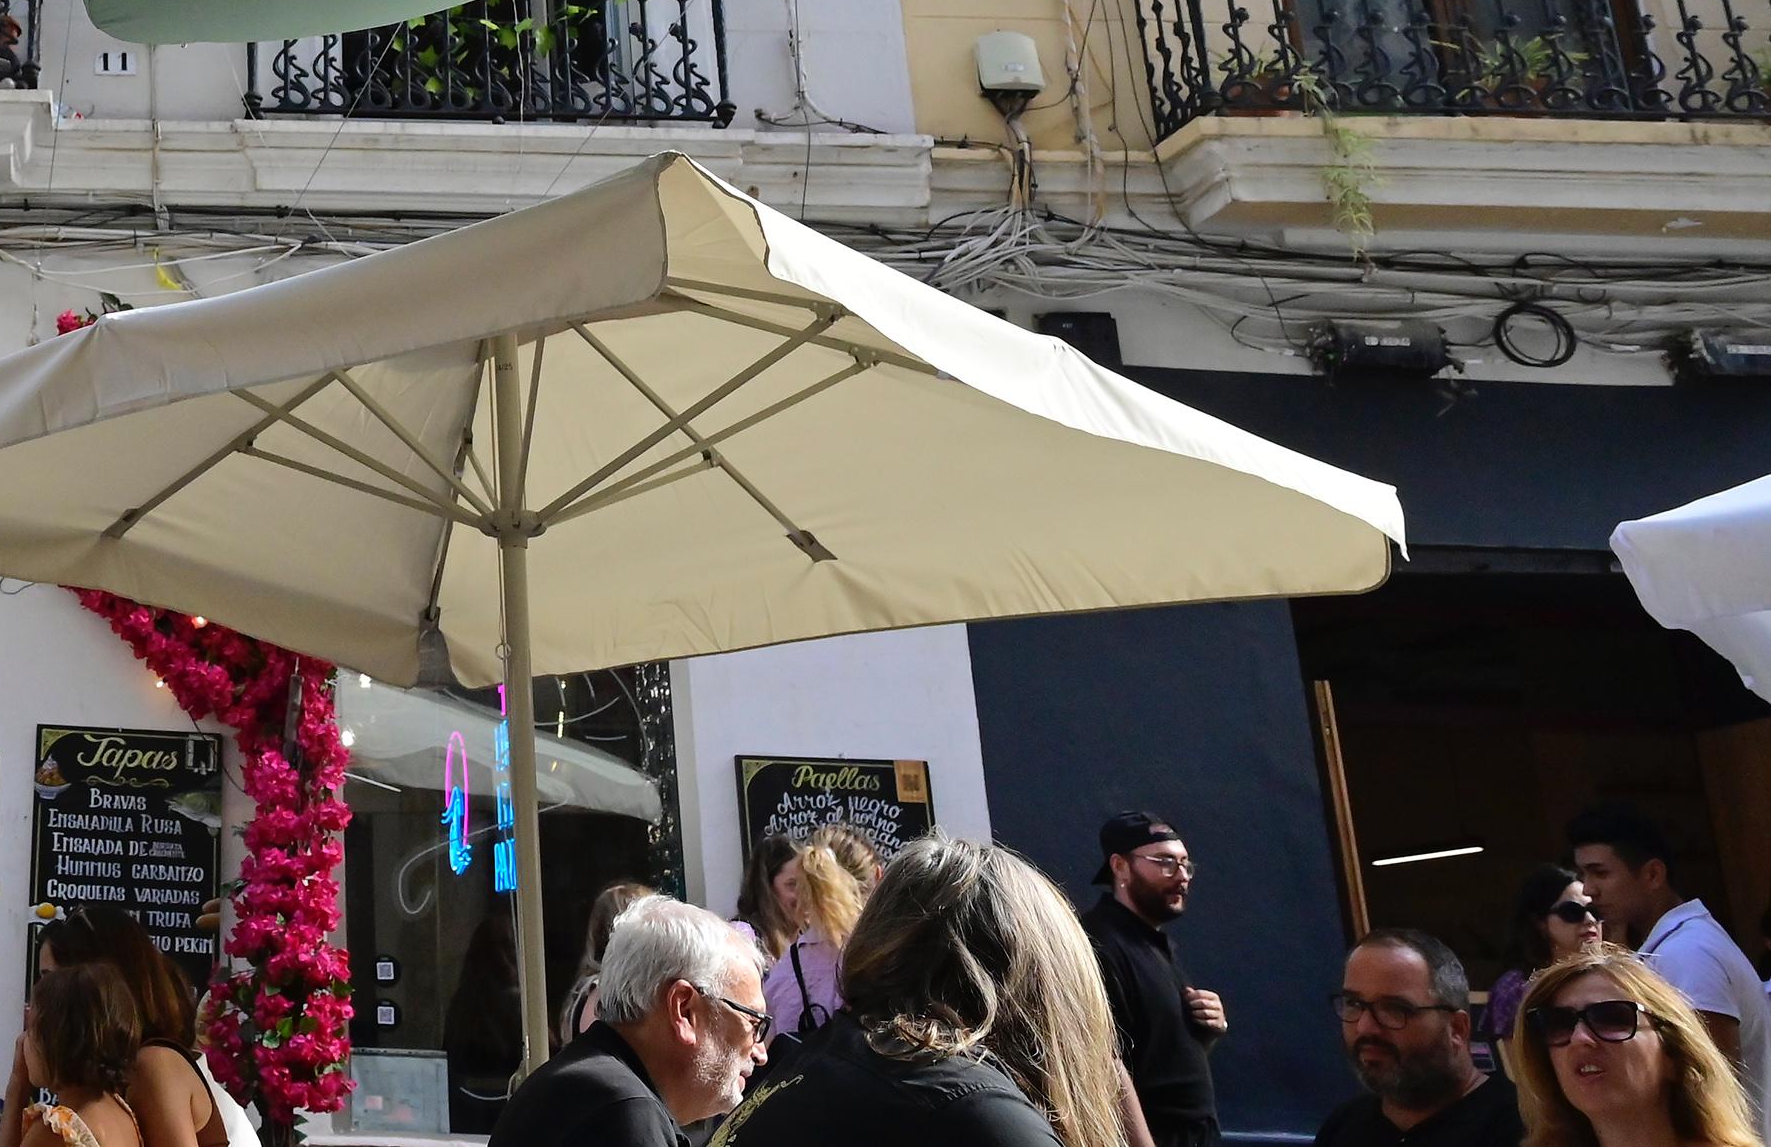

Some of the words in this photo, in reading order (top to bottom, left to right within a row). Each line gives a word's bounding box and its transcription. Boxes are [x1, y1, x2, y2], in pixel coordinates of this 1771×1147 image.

[99, 52, 128, 71] 11
[77, 734, 178, 779] Tapas
[791, 765, 881, 791] Paellas
[89, 787, 147, 811] BRAVAS
[777, 790, 842, 815] Arroz
[47, 808, 134, 833] ENSALADILLA
[141, 813, 183, 836] RUSA
[51, 832, 124, 856] ENSALADA
[128, 840, 149, 857] DE
[54, 854, 122, 879] HUMMUS
[46, 878, 126, 902] CROQUETAS
[133, 887, 200, 905] VARIADAS
[146, 910, 192, 929] TRUFA
